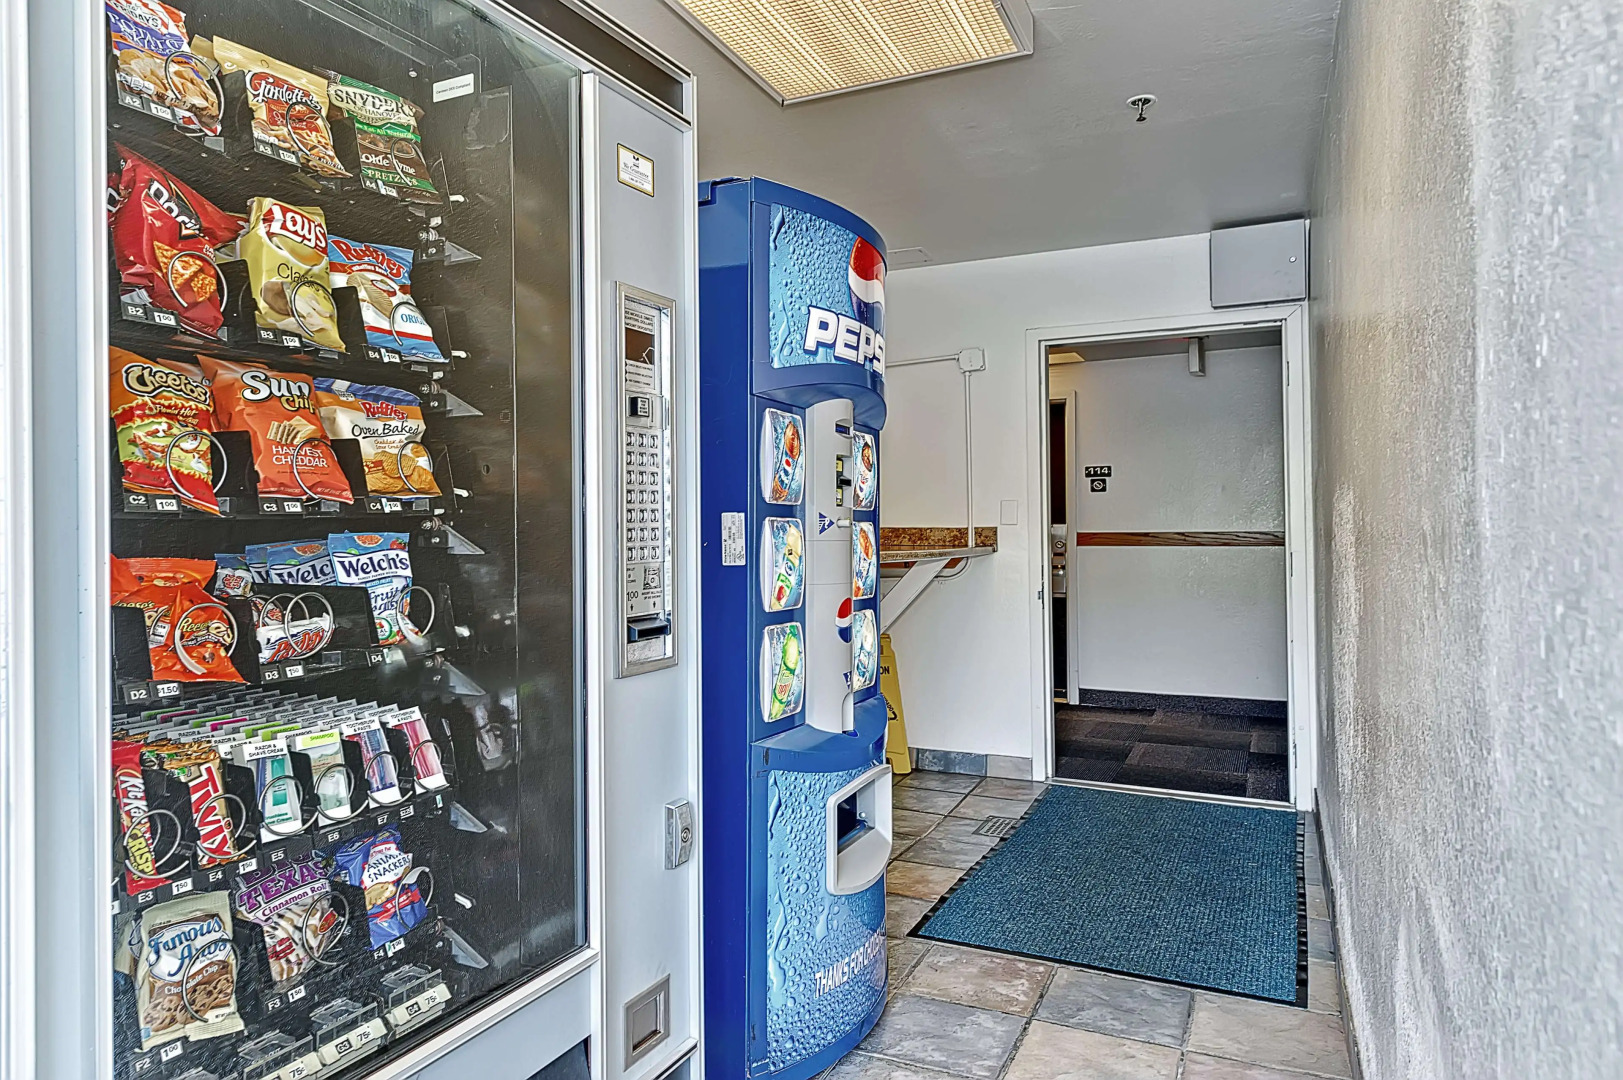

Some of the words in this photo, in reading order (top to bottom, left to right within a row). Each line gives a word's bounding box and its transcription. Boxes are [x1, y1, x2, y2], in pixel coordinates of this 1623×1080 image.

[125, 95, 141, 106] A2
[259, 145, 273, 155] A3
[361, 153, 390, 167] Olde
[367, 169, 418, 186] PRETZLS
[366, 180, 376, 189] A4
[269, 204, 327, 248] Lay's
[331, 239, 406, 279] Ruffles
[127, 306, 145, 315] B2
[260, 330, 274, 339] B3
[804, 305, 885, 377] PEPS
[368, 350, 380, 359] B4
[127, 365, 206, 402] Cheetos
[241, 371, 311, 402] Sun
[180, 407, 199, 417] Hot
[360, 400, 407, 422] Ruffles
[351, 423, 380, 438] Oven
[382, 422, 420, 437] Baked
[1088, 467, 1108, 475] 114
[129, 495, 147, 505] C2
[263, 503, 278, 512] C3
[370, 502, 381, 510] C4
[337, 553, 410, 578] Welch's
[371, 655, 382, 663] D4
[264, 671, 279, 680] D3
[130, 689, 147, 700] D2
[391, 710, 416, 719] TOOTHBRUSH
[346, 719, 376, 729] TOOTHBRUSH
[310, 732, 335, 741] SHAMPOO
[248, 750, 267, 758] SHAVE
[189, 764, 233, 856] TWIX
[377, 815, 388, 825] E7
[328, 832, 340, 842] E6
[271, 850, 285, 861] E5
[367, 852, 403, 872] ANIM
[368, 855, 411, 882] SNACKERS
[208, 871, 223, 882] E4
[240, 860, 329, 911] TEXAS
[138, 893, 153, 903] E3
[262, 892, 309, 917] Cinnamon
[148, 916, 223, 967] Famous
[374, 949, 385, 959] F4
[165, 973, 203, 995] Choolate
[203, 964, 219, 976] Chip
[814, 956, 849, 999] THANKS
[268, 1000, 281, 1011] F3
[407, 1004, 420, 1014] G4
[337, 1040, 350, 1050] G3
[135, 1060, 150, 1072] F2
